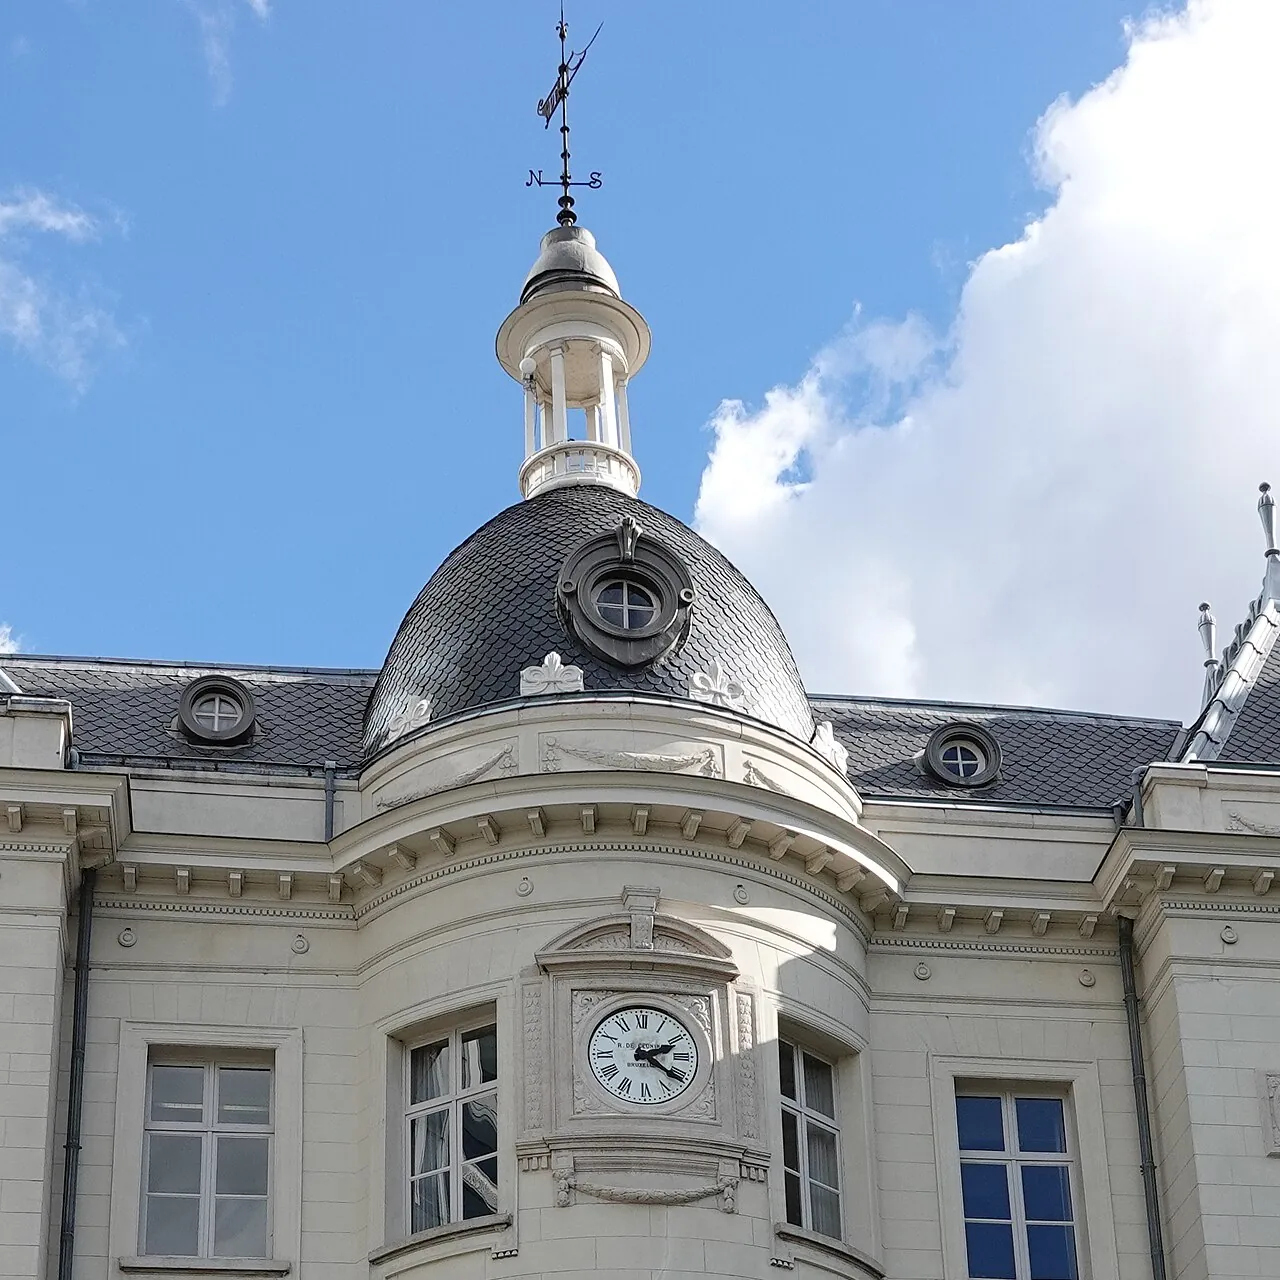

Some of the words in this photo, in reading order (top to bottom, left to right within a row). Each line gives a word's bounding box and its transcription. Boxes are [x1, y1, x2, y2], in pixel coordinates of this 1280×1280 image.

[526, 169, 543, 187] N
[588, 171, 602, 189] S
[615, 1018, 631, 1034] XI
[635, 1014, 648, 1029] XII
[656, 1020, 666, 1033] I
[601, 1031, 618, 1044] X
[668, 1034, 683, 1045] II
[597, 1048, 614, 1059] IX
[673, 1052, 689, 1062] III
[601, 1063, 620, 1081] VIII
[617, 1077, 632, 1094] VII
[641, 1083, 652, 1098] VI
[659, 1080, 671, 1095] V
